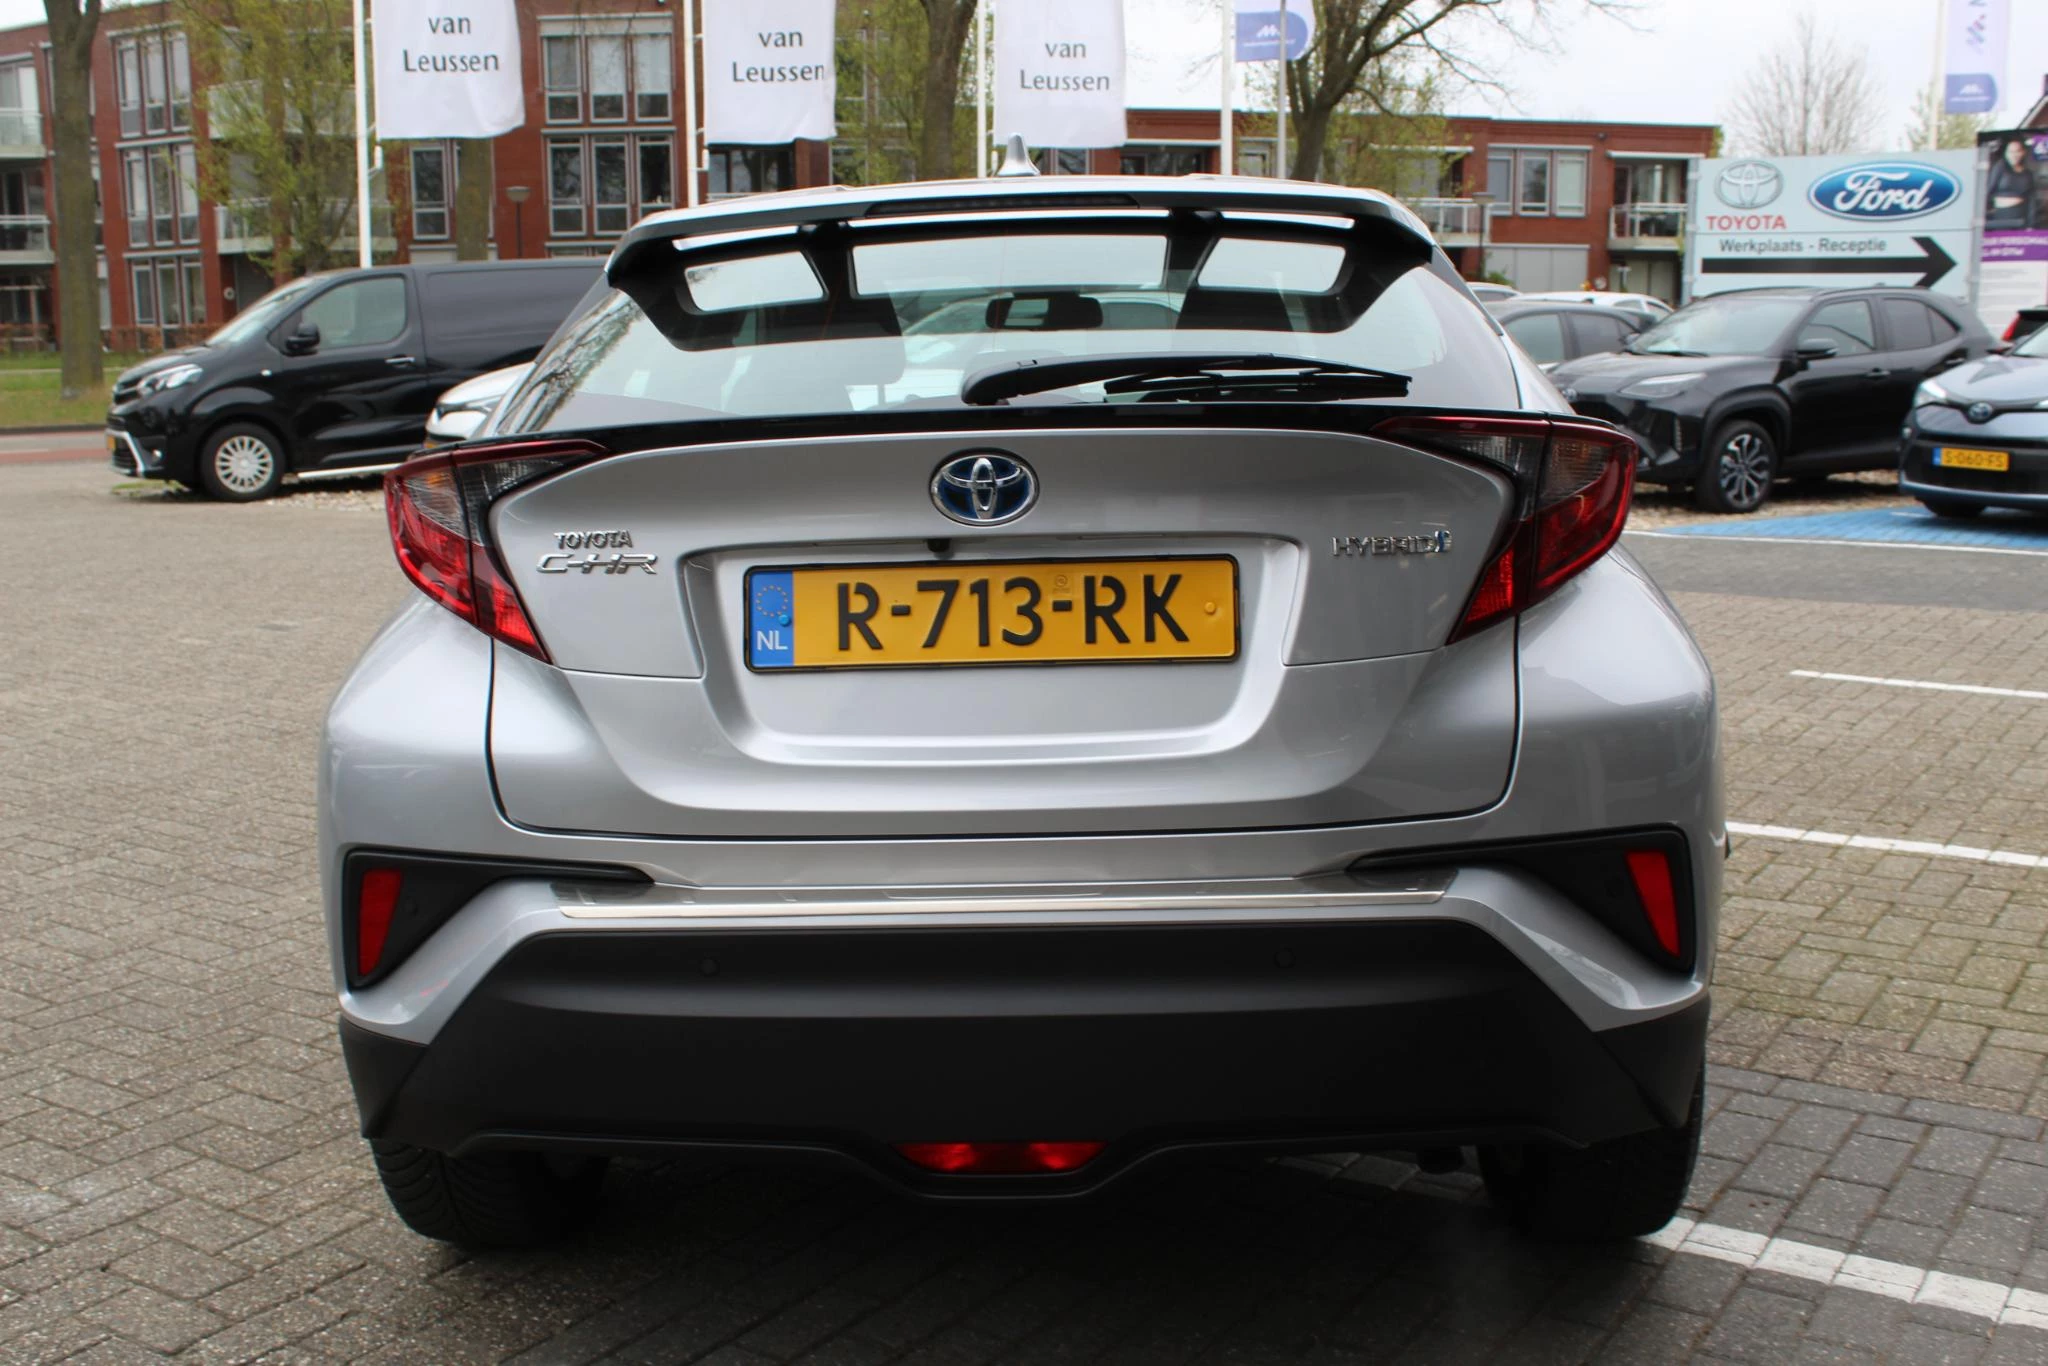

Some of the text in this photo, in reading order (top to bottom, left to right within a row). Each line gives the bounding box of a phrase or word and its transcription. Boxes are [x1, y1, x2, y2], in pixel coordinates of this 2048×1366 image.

[428, 16, 471, 34] van
[758, 31, 803, 47] van
[1045, 42, 1086, 58] van
[403, 49, 499, 72] Leussen
[732, 61, 825, 82] Leussen
[1020, 69, 1110, 91] Leussen
[1834, 170, 1934, 212] Ford
[1706, 215, 1787, 231] TOYOTA
[1719, 238, 1803, 255] Werkplaats
[1818, 237, 1887, 254] Receptie
[554, 530, 633, 549] TOYOTA
[1332, 536, 1437, 556] HYBRID
[536, 553, 658, 575] C-HR
[836, 573, 1190, 651] R-713-RK
[756, 630, 788, 651] NL
